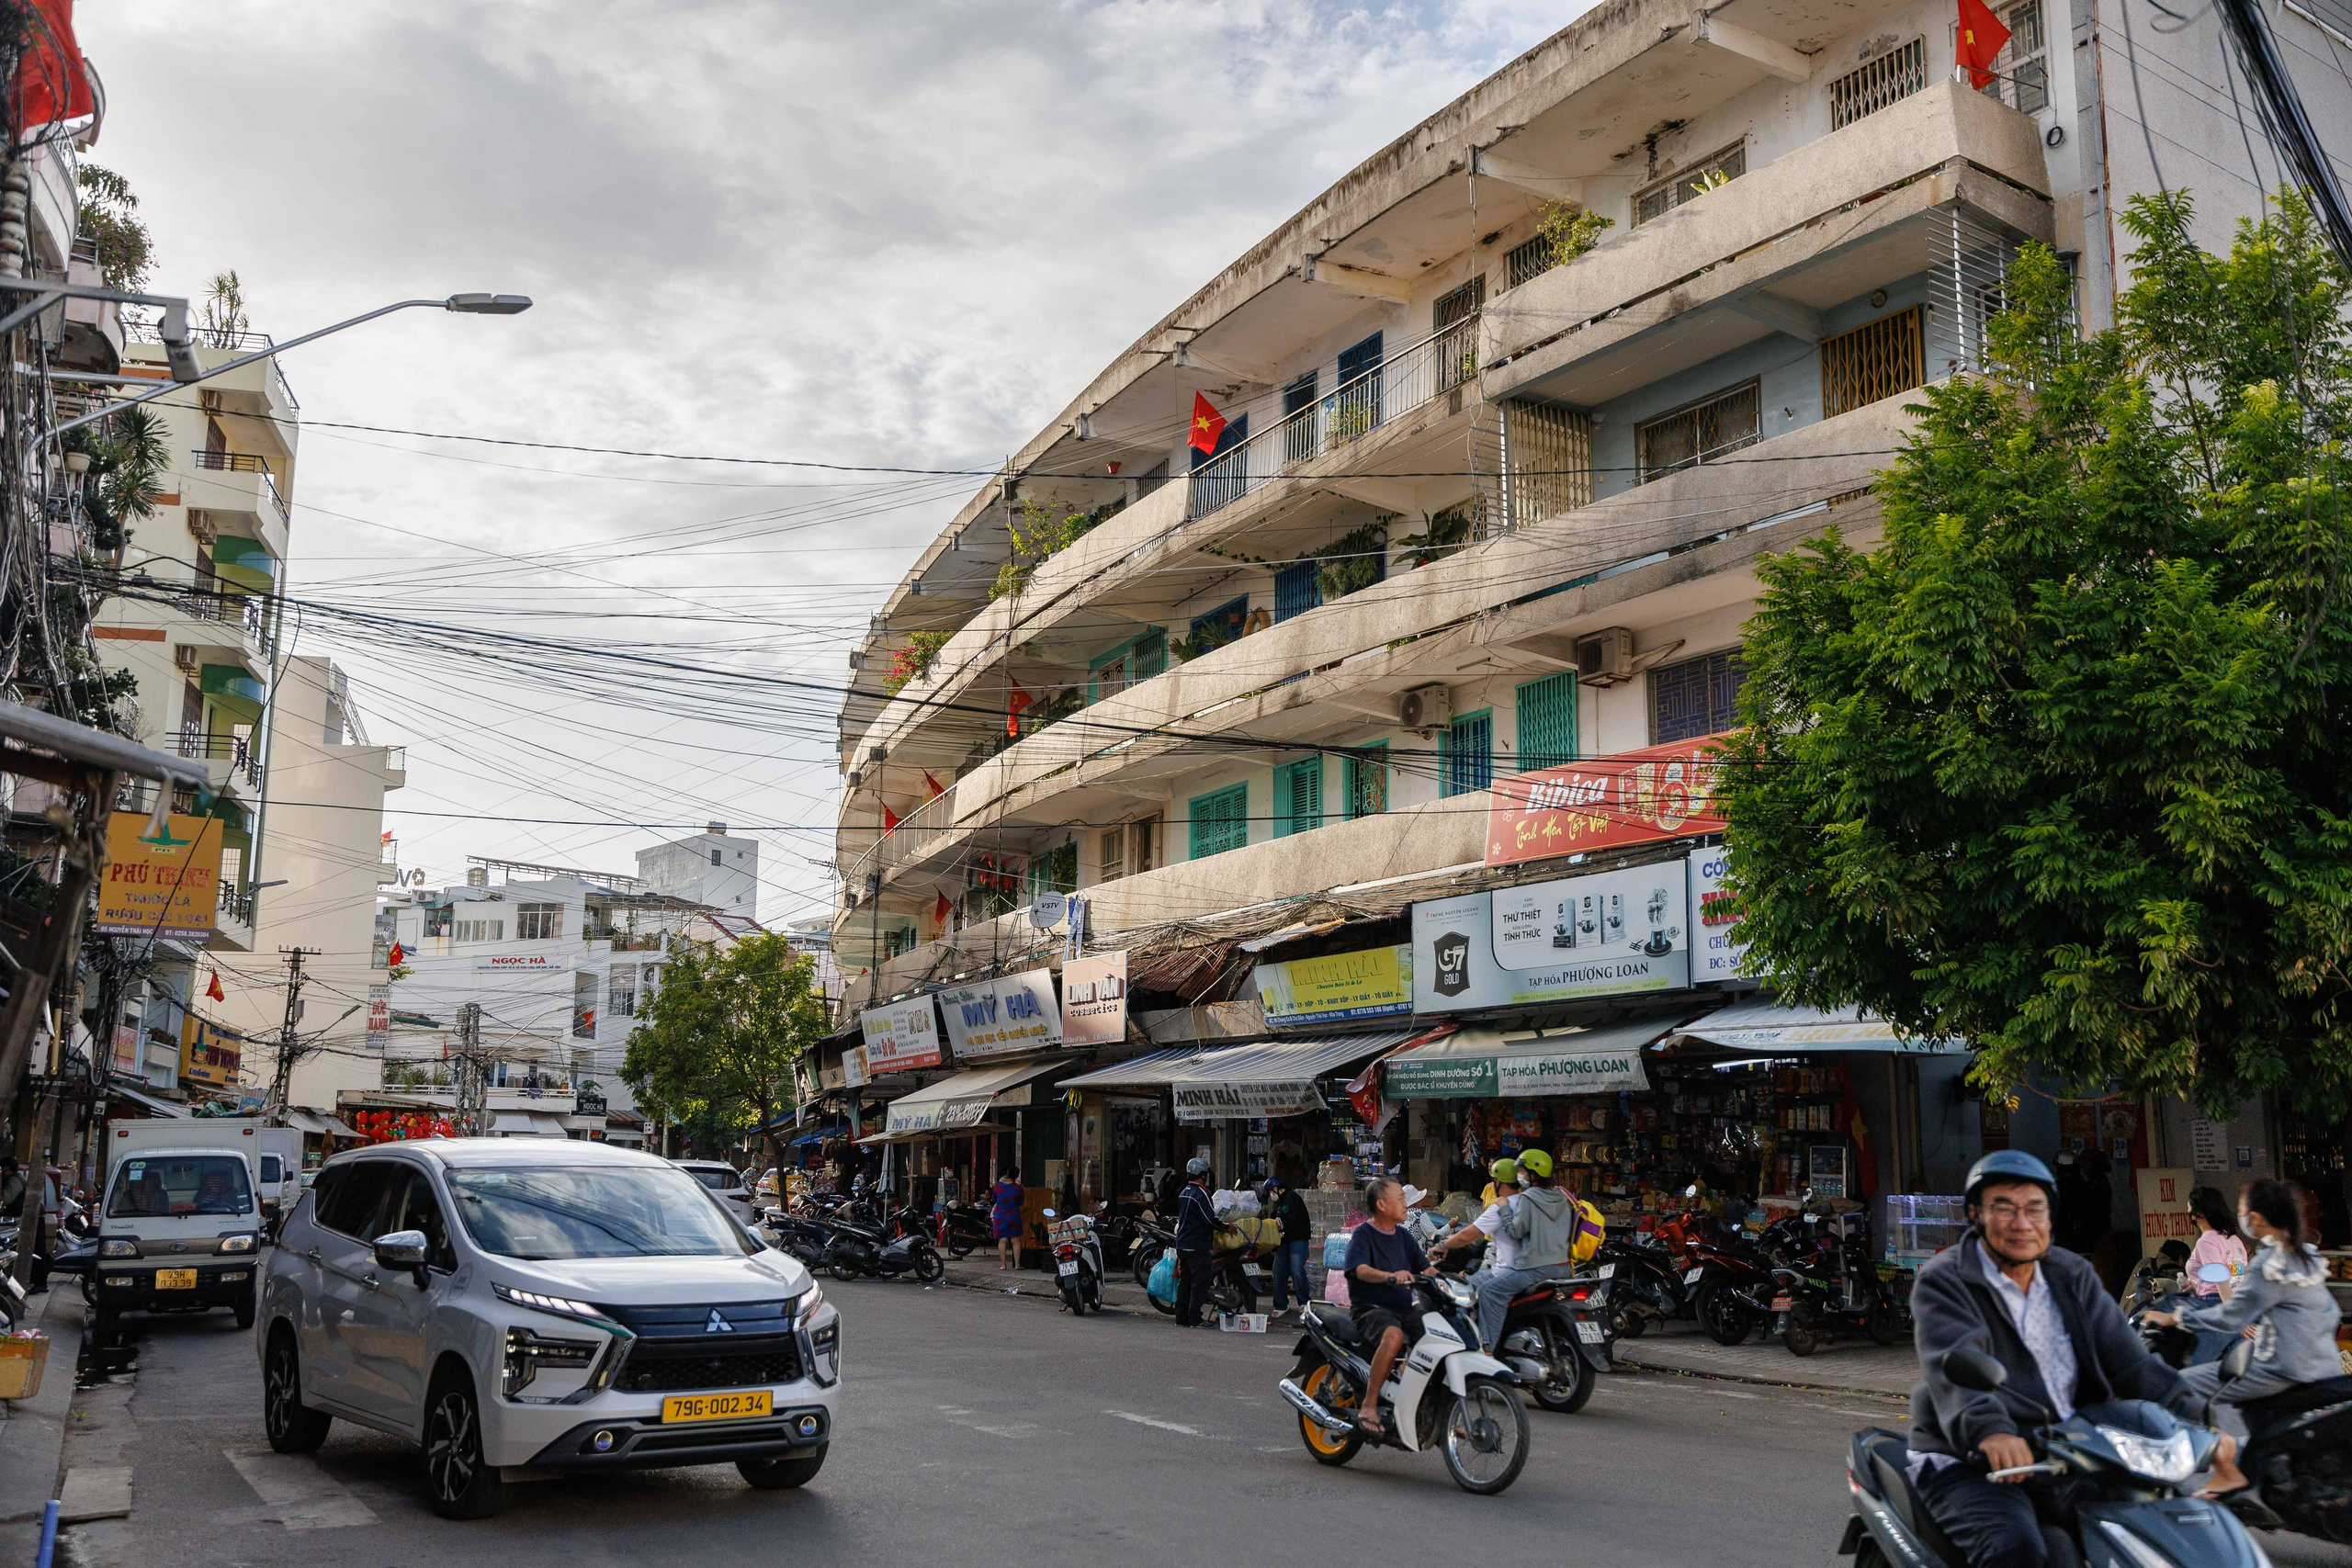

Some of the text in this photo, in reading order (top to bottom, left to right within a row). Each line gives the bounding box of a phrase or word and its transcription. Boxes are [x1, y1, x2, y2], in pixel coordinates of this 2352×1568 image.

[1525, 773, 1608, 814] Bibica
[1516, 807, 1612, 849] Tinh Hoa Tết Việt
[110, 860, 211, 891] PHÚ THỊNH
[125, 891, 191, 907] THUỐC LÁ
[106, 908, 208, 926] RƯỢU CÁC LOẠI
[1503, 908, 1541, 923] THỨ THIỆT
[108, 925, 129, 933] NGUYỄN
[1522, 928, 1541, 939] THỨC
[492, 957, 526, 965] NGỌC
[1709, 950, 1742, 969] ĐC: SỐ
[1290, 953, 1384, 986] MINH HẢI
[1529, 963, 1648, 987] TẠP HÓA PHƯỢNG LOAN
[1444, 973, 1459, 985] GOLD
[1068, 982, 1094, 1005] LINH
[1340, 995, 1349, 1003] XỐP
[1382, 989, 1393, 998] GIẤY
[372, 998, 387, 1015] ĐỨC
[961, 986, 1042, 1027] MỸ HÀ
[1069, 1003, 1118, 1017] cosmetics
[368, 1018, 389, 1033] HẠNH
[1447, 1068, 1469, 1077] DƯỠNG
[1472, 1064, 1482, 1077] SỐ
[1485, 1061, 1493, 1076] 1
[1502, 1059, 1630, 1078] TẠP HÓA PHƯỢNG LOAN
[1401, 1082, 1416, 1090] ĐƯỢC
[1418, 1081, 1429, 1089] BÁC
[1176, 1083, 1242, 1106] MINH HẢI
[583, 1102, 596, 1111] NGỌC
[892, 1113, 931, 1129] MỸ HÀ
[2116, 1139, 2124, 1149] 23
[2159, 1179, 2176, 1202] KIM
[2144, 1209, 2168, 1237] HƯNG
[168, 1270, 186, 1279] 79H
[1416, 1350, 1433, 1363] YAMAHA
